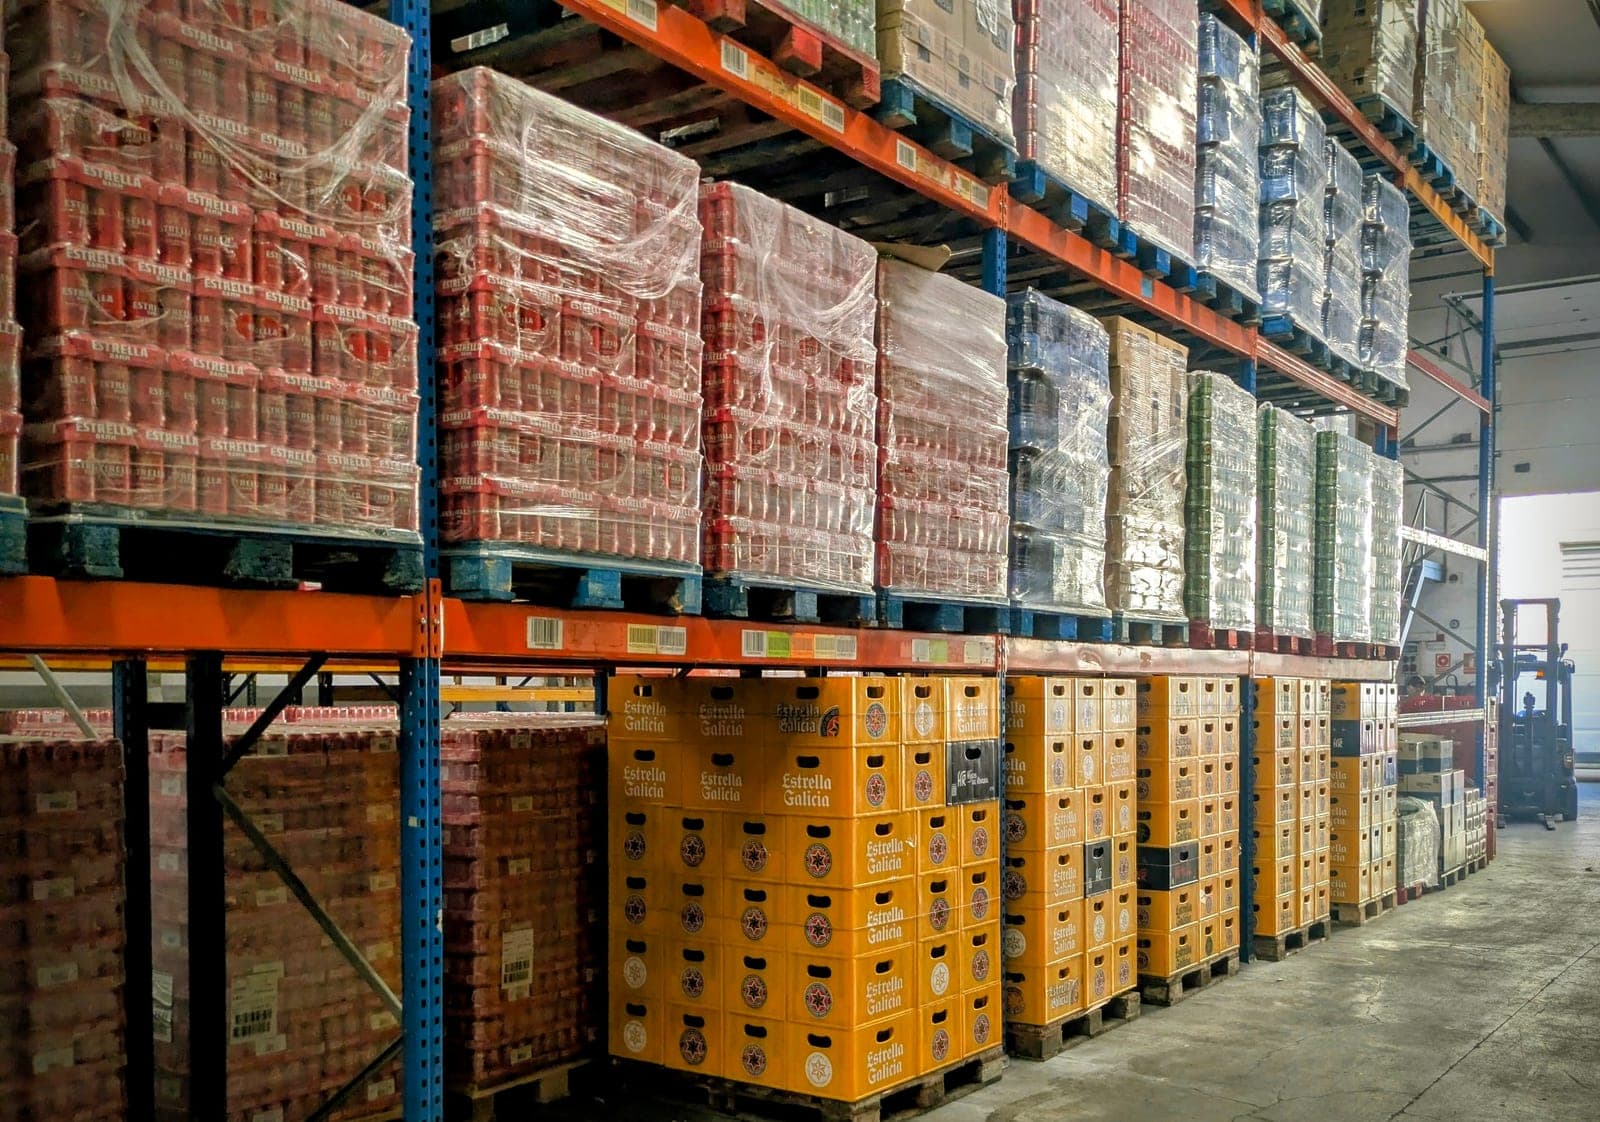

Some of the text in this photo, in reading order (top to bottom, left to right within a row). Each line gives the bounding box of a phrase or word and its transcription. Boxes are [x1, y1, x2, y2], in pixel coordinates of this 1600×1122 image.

[275, 62, 321, 84] ESTRELLA
[83, 163, 142, 189] ESTRELLA
[186, 191, 240, 216] ESTRELLA
[279, 219, 327, 239] ESTRELLA
[65, 245, 126, 268] ESTRELLA
[138, 262, 194, 284] ESTRELLA
[204, 278, 256, 299] ESTRELLA
[265, 291, 313, 312] ESTRELLA
[323, 303, 369, 321] ESTRELLA
[91, 340, 149, 359] ESTRELLA
[192, 356, 245, 377] ESTRELLA
[561, 362, 594, 378] ESTRELLA
[284, 374, 333, 391] ESTRELLA
[619, 377, 650, 390] ESTRELLA
[76, 422, 137, 437] ESTRELLA
[145, 431, 200, 448] ESTRELLA
[210, 440, 264, 456] ESTRELLA
[270, 449, 318, 466] ESTRELLA
[561, 488, 594, 503] ESTRELLA
[618, 498, 647, 511] ESTRELLA
[623, 699, 667, 718] Estrella
[776, 703, 821, 719] Estrella
[625, 717, 665, 733] Galicia
[701, 719, 743, 737] Galicia
[779, 718, 817, 734] Galicia
[622, 766, 666, 783] Estrella
[700, 771, 743, 787] Estrella
[783, 773, 832, 791] Estrella
[624, 781, 664, 799] Galicia
[701, 786, 741, 802] Galicia
[783, 789, 830, 808] Galicia
[866, 837, 904, 858] Estrella
[867, 855, 903, 875] Galicia
[867, 906, 904, 928] Estrella
[867, 924, 902, 945] Galicia
[866, 976, 904, 998] Estrella
[866, 994, 902, 1016] Galicia
[867, 1042, 904, 1065] Estrella
[867, 1061, 903, 1085] Galicia
